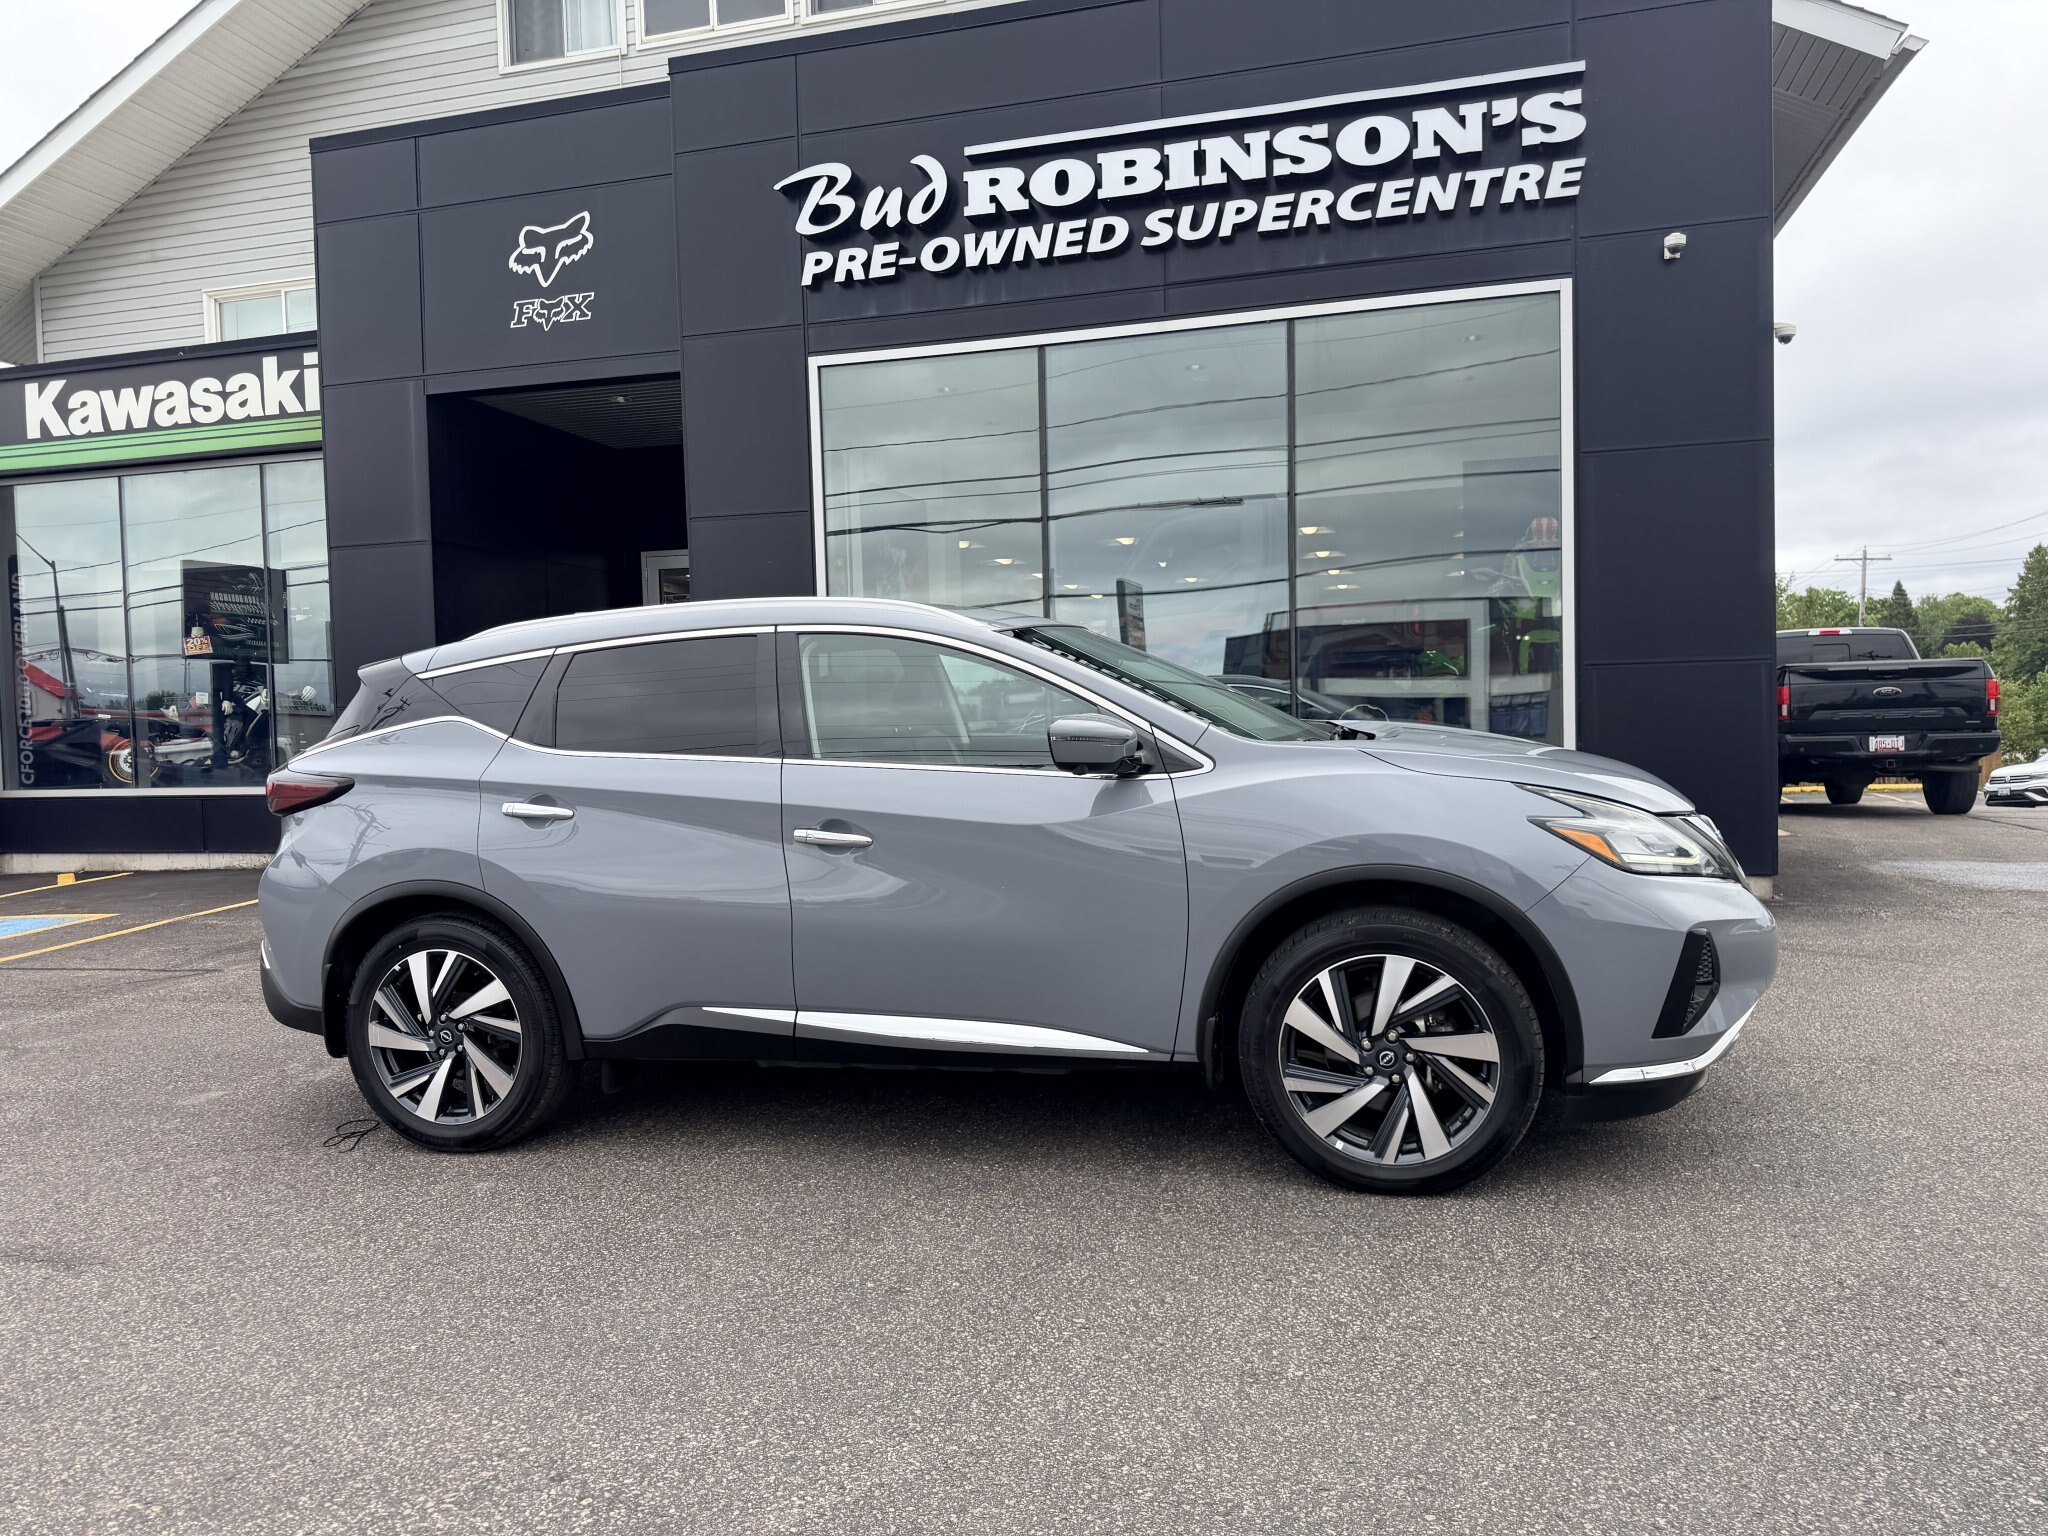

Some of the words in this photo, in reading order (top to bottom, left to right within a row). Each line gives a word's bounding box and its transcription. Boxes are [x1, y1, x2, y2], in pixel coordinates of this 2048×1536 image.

[773, 154, 948, 236] Bud
[962, 88, 1587, 217] ROBINSON'S
[800, 208, 1130, 286] PRE-OWNED
[1140, 157, 1587, 247] SUPERCENTRE
[510, 291, 595, 331] FOX
[24, 352, 321, 440] Kawasaki
[11, 572, 30, 670] OVERLAND
[186, 637, 208, 646] 20%
[19, 718, 35, 785] CFORCE
